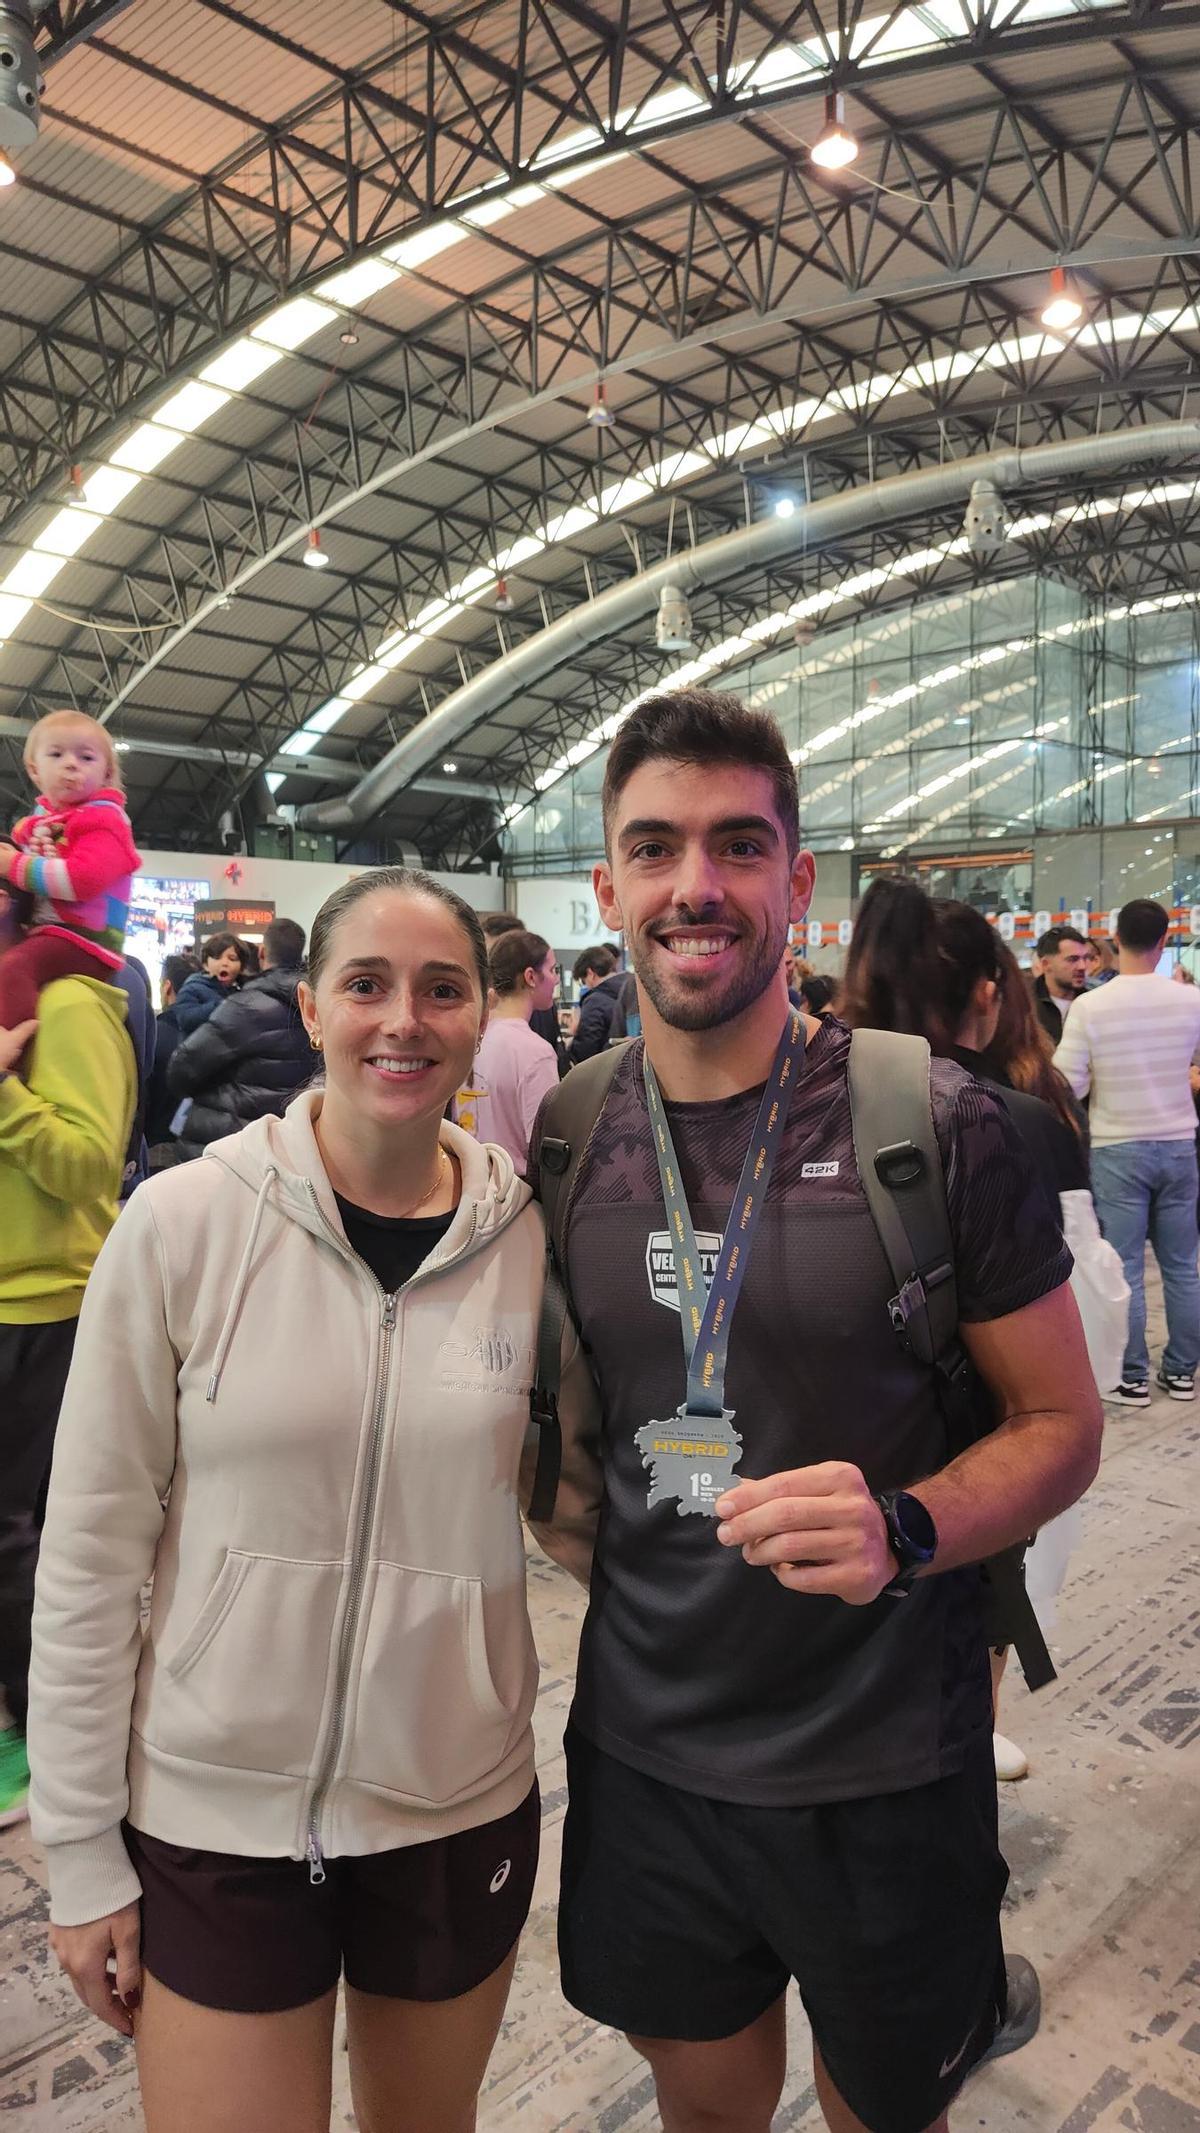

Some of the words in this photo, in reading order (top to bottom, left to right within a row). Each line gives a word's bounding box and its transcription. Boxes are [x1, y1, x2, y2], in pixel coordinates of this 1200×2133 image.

[227, 909, 273, 923] HYBRID
[779, 1057, 791, 1088] HYBRID
[766, 1101, 779, 1133] HYBRID
[753, 1148, 767, 1181] HYBRID
[805, 1165, 836, 1174] 42K
[739, 1195, 753, 1230] HYBRID
[651, 1252, 719, 1272] VELTY
[726, 1246, 740, 1281] HYBRID
[712, 1298, 726, 1335] HYBRID
[703, 1351, 714, 1389] HYBRID
[655, 1440, 729, 1457] HYBRID
